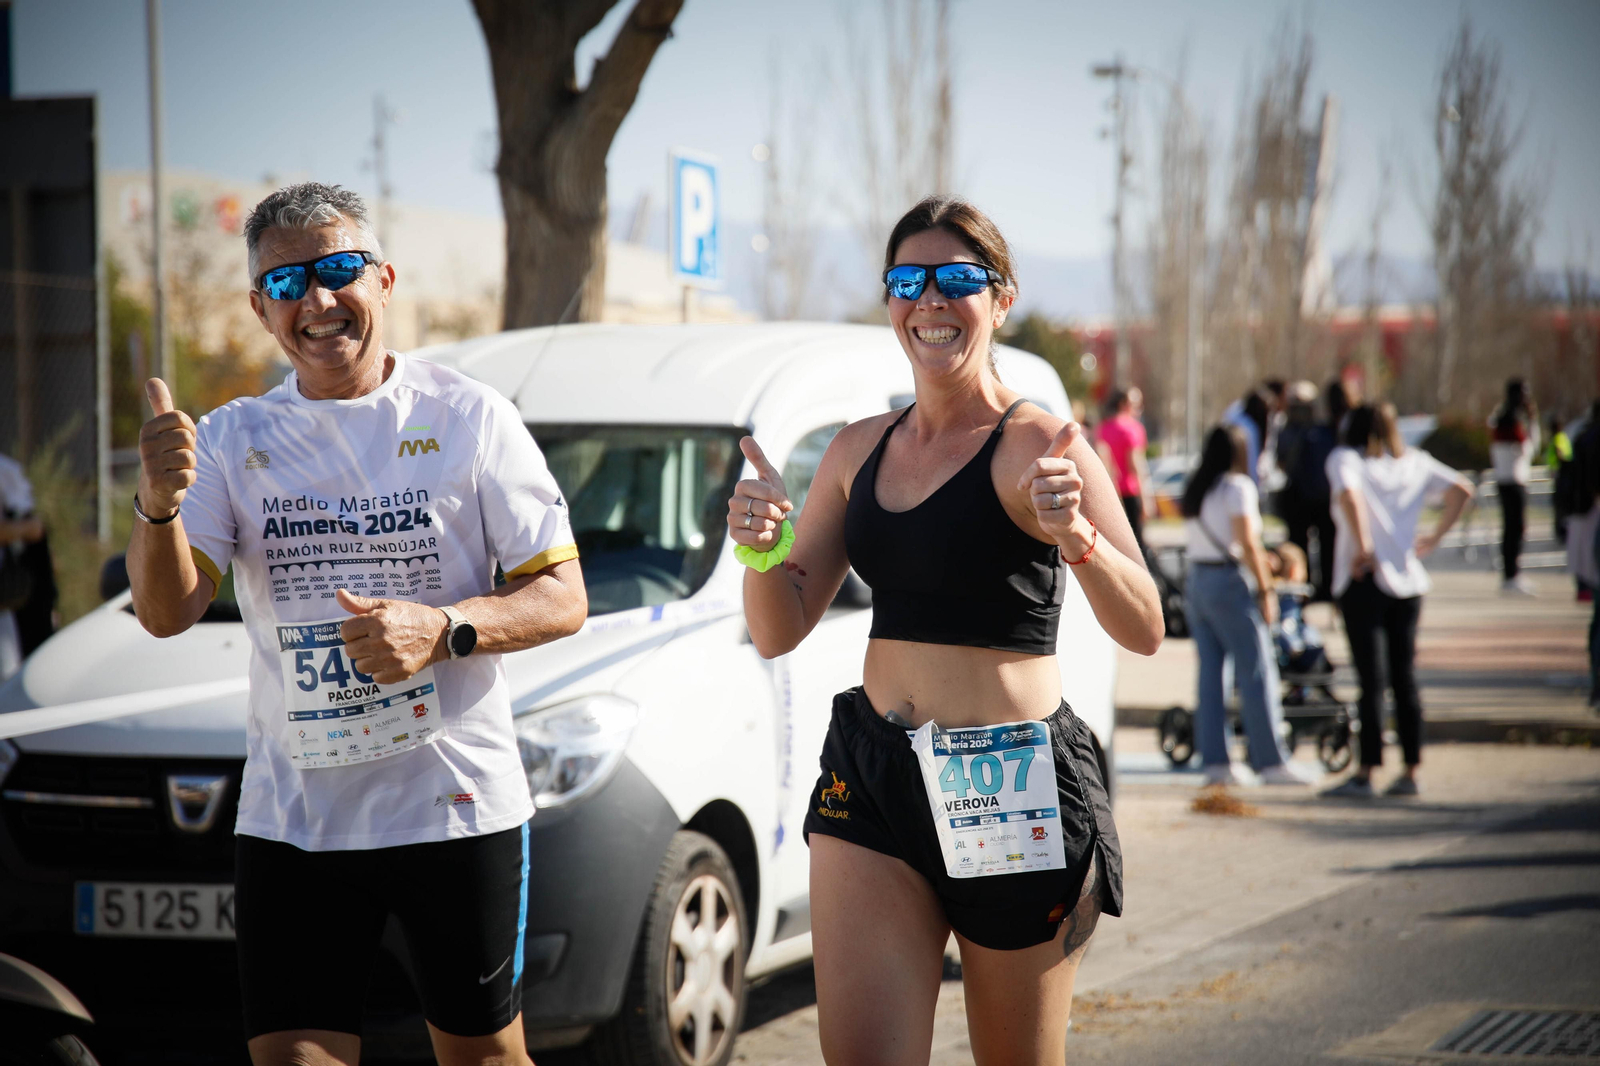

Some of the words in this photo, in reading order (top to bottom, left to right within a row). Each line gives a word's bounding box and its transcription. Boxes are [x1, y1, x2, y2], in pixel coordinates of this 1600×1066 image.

[680, 166, 714, 269] P
[246, 446, 270, 464] 25
[262, 494, 328, 514] Medio
[339, 487, 429, 513] Maratón
[262, 514, 359, 539] Almería
[364, 507, 433, 536] 2024
[266, 542, 323, 560] RAMÓN
[329, 542, 364, 554] RUIZ
[369, 536, 437, 553] ANDÚJAR
[272, 578, 287, 586] 1998
[291, 576, 306, 584] 1999
[328, 574, 344, 582] 2001
[347, 573, 364, 581] 2002
[294, 584, 310, 592] 2008
[313, 583, 329, 591] 2009
[333, 582, 348, 590] 2010
[353, 581, 368, 589] 2011
[370, 589, 386, 597] 2020
[426, 583, 442, 591] 2024
[311, 625, 334, 634] Medio
[314, 631, 342, 643] Almerí
[327, 684, 381, 702] PACOVA
[363, 696, 376, 704] VACA
[933, 733, 958, 741] Mio
[960, 732, 993, 740] Maratón
[970, 738, 993, 749] 2024
[938, 747, 1036, 798] 407
[945, 796, 999, 812] VEROVA
[104, 888, 200, 930] 5125
